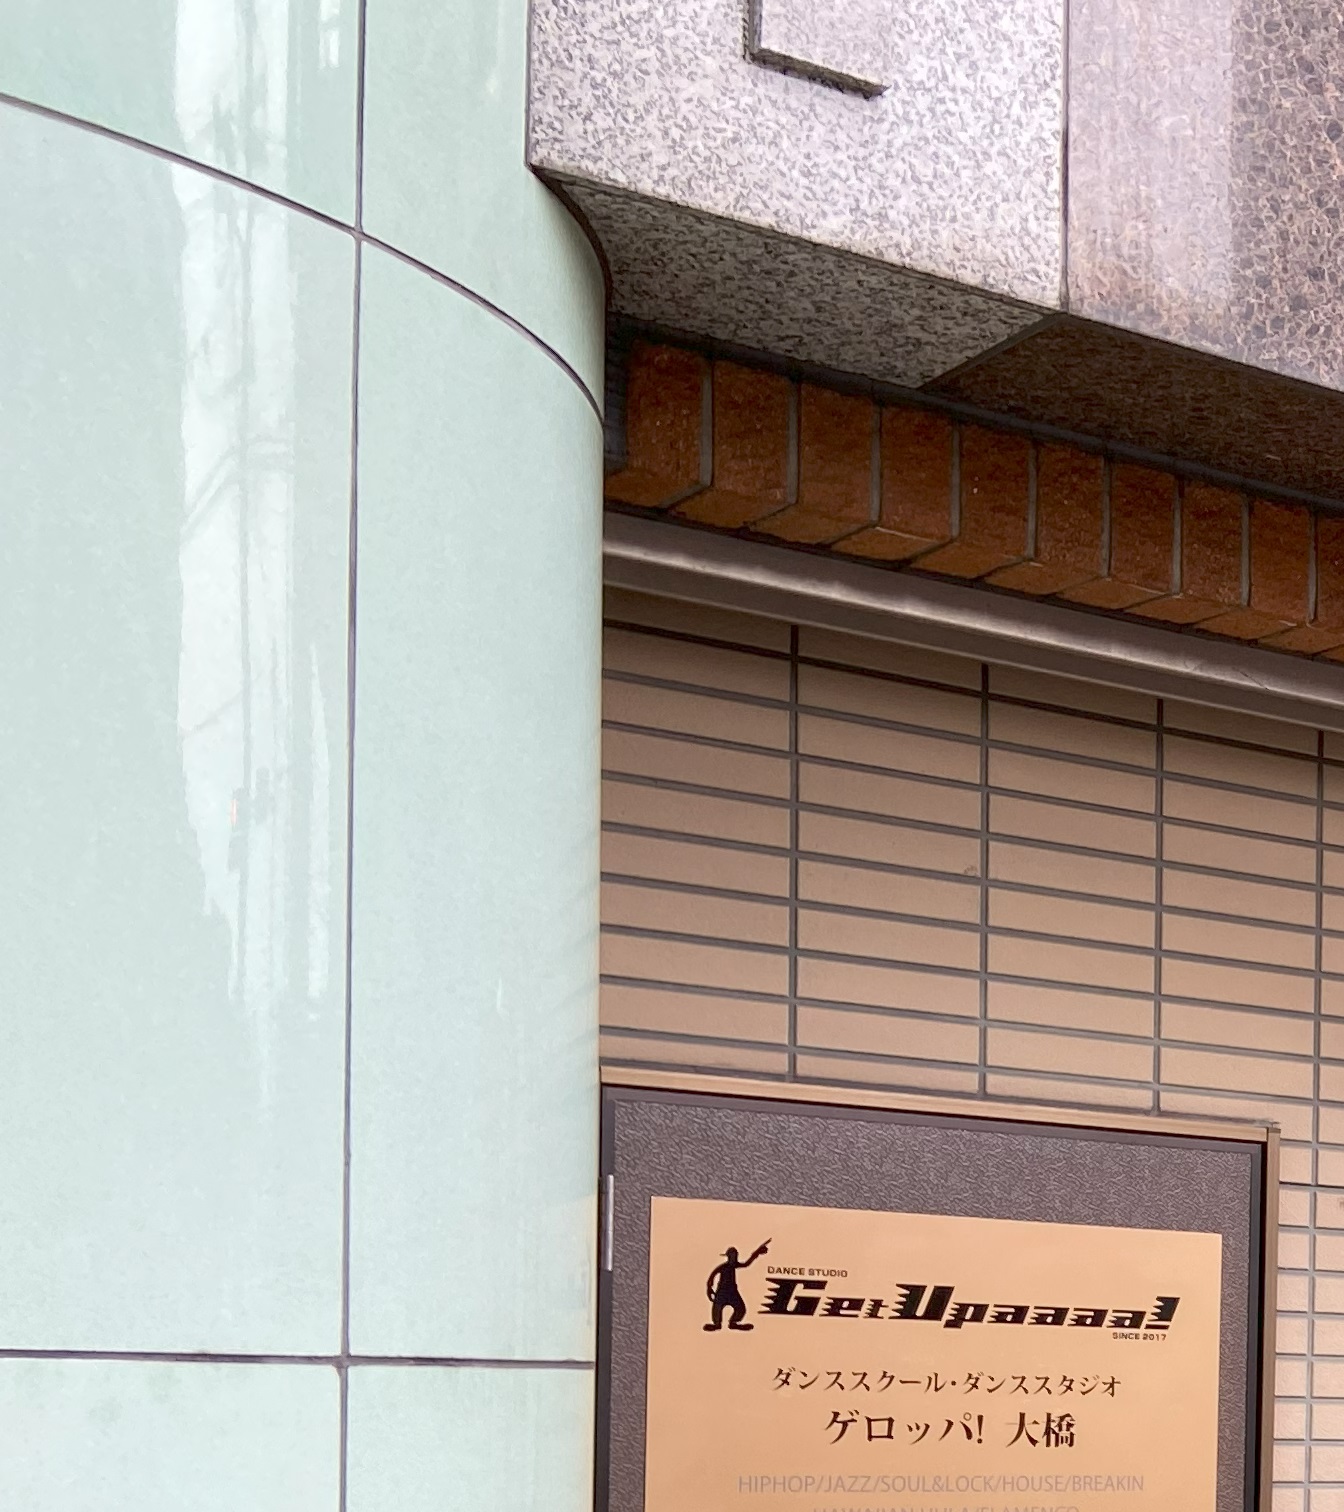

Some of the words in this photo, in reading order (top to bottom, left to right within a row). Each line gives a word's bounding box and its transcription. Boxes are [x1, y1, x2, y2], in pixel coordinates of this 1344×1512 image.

[767, 1265, 805, 1276] DANCE
[808, 1268, 848, 1278] STUDIO
[1112, 1331, 1141, 1341] SINCE
[1143, 1333, 1167, 1342] 2017
[772, 1366, 1122, 1398] ダンススクール・ダンススタジオ
[1005, 1411, 1077, 1448] 大橋
[738, 1474, 1145, 1493] HIPHOP/JAZZ/SOUL&LOCK/HOUSE/BREAKIN
